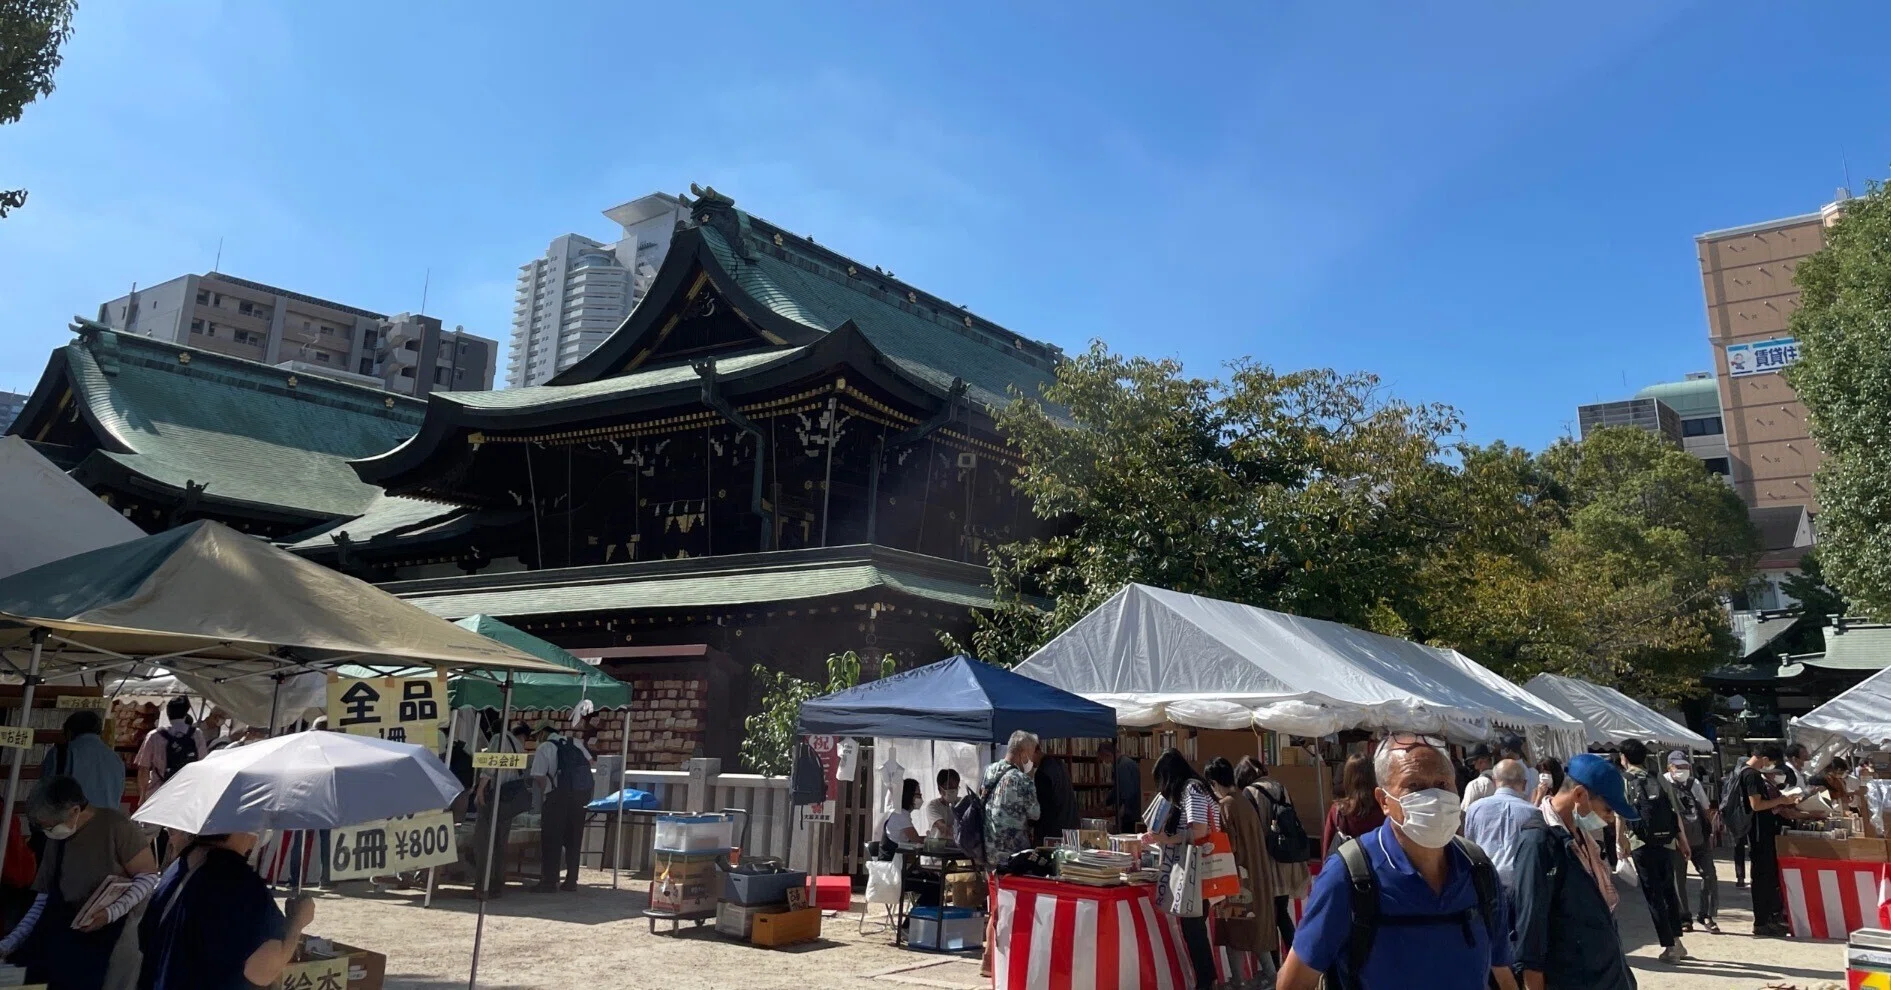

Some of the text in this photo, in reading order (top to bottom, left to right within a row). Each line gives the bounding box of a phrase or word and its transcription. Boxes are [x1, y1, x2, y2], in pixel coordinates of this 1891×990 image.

[339, 680, 437, 726] 全品
[7, 730, 28, 746] お会計
[488, 755, 520, 767] お会計
[333, 824, 448, 871] 6冊 ¥800
